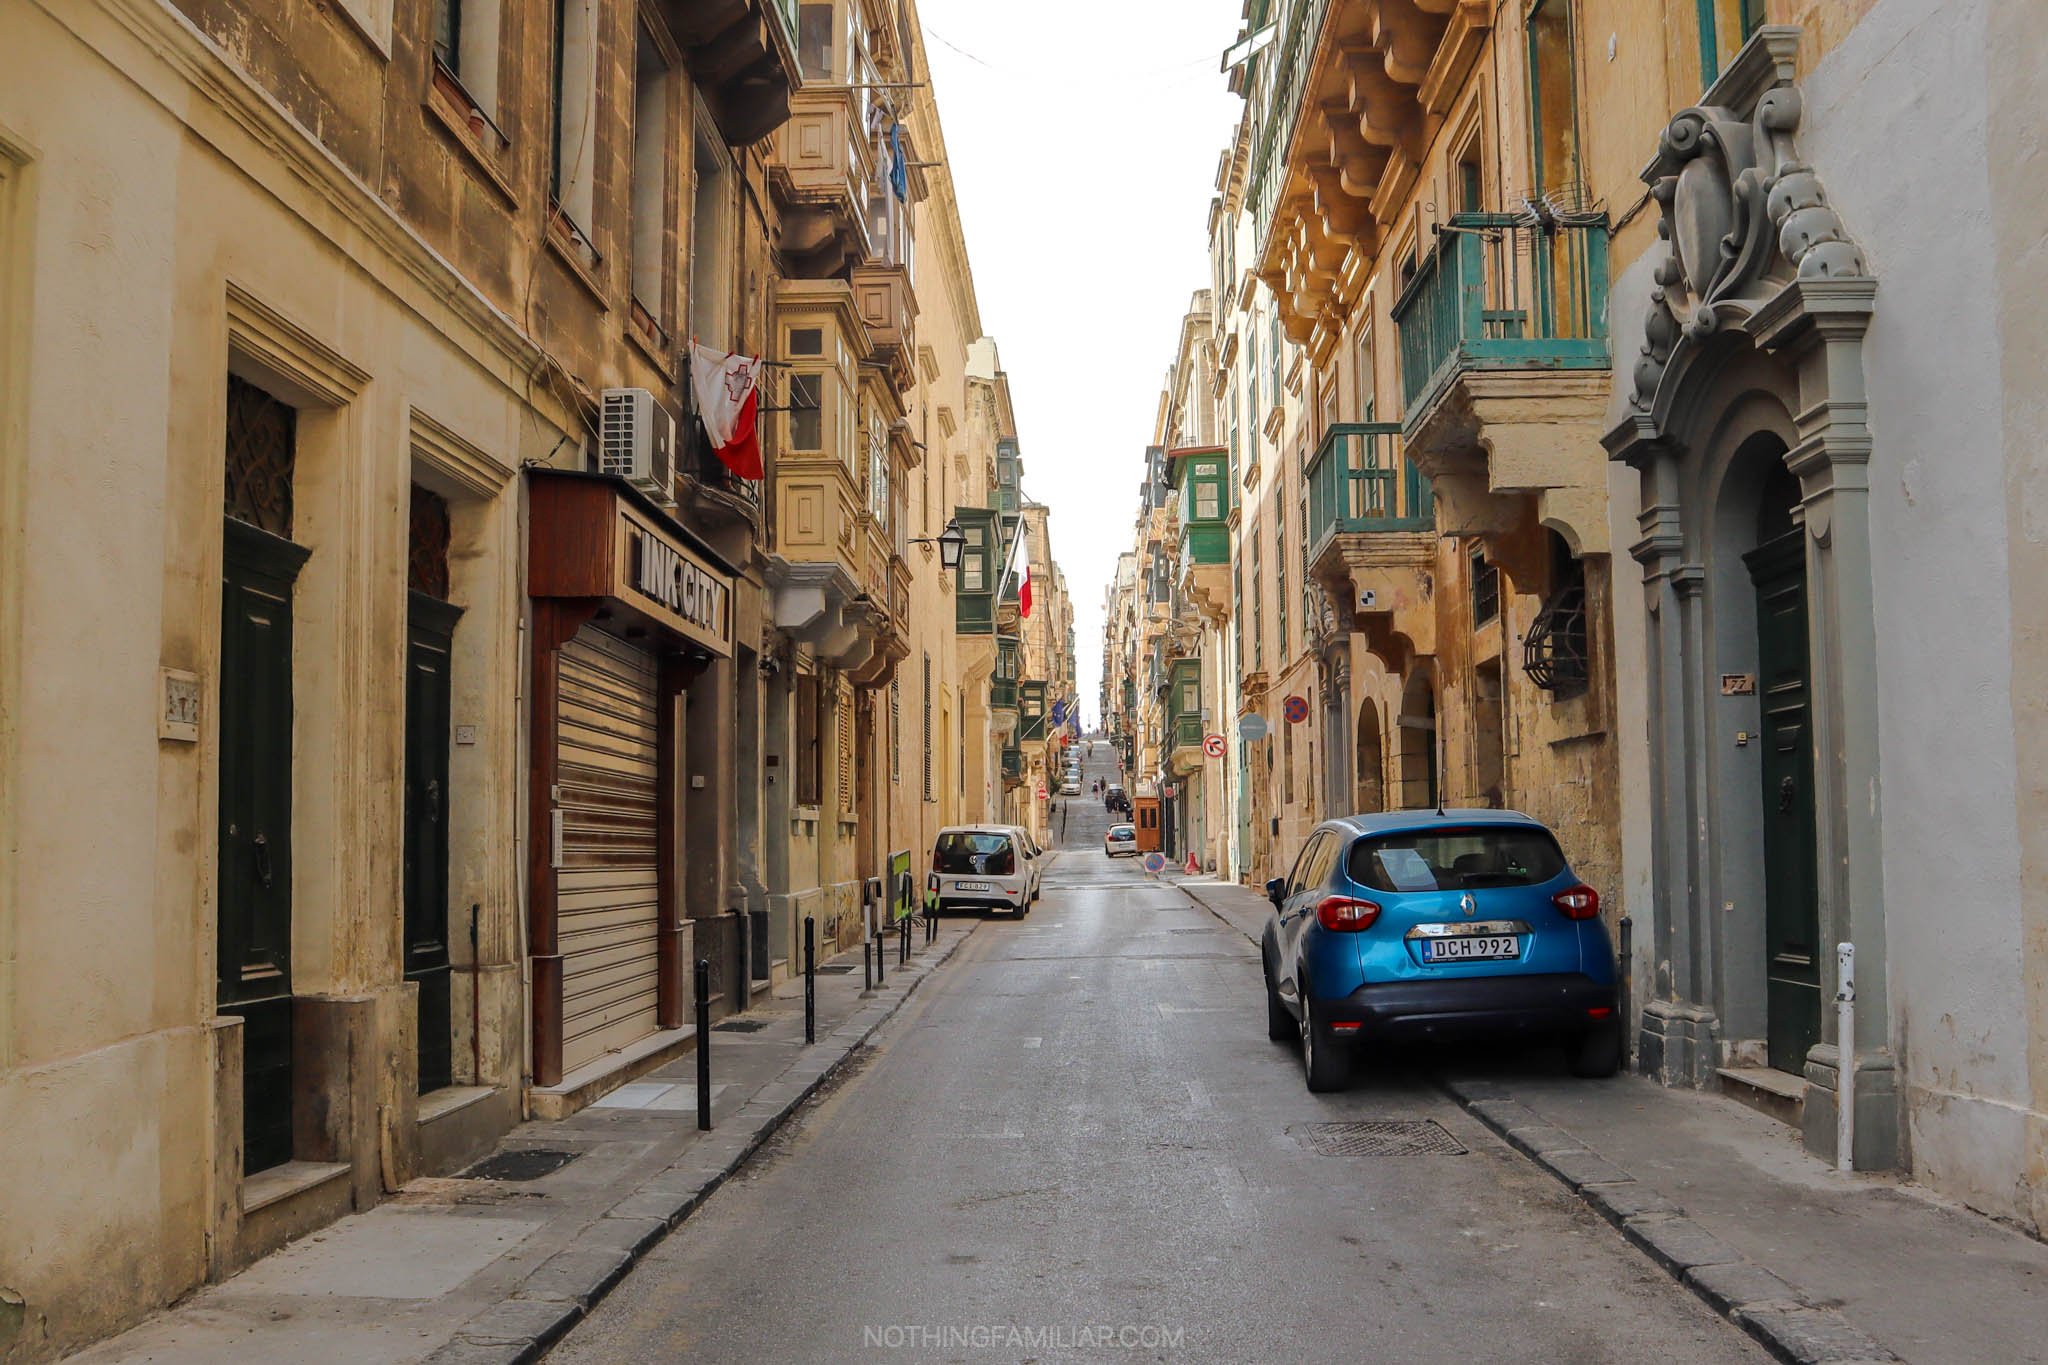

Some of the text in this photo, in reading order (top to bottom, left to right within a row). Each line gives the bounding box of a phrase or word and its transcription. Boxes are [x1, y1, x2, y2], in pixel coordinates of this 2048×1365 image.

[641, 530, 721, 632] INK CITY
[1731, 679, 1747, 690] 77
[1436, 938, 1513, 957] DCH 992
